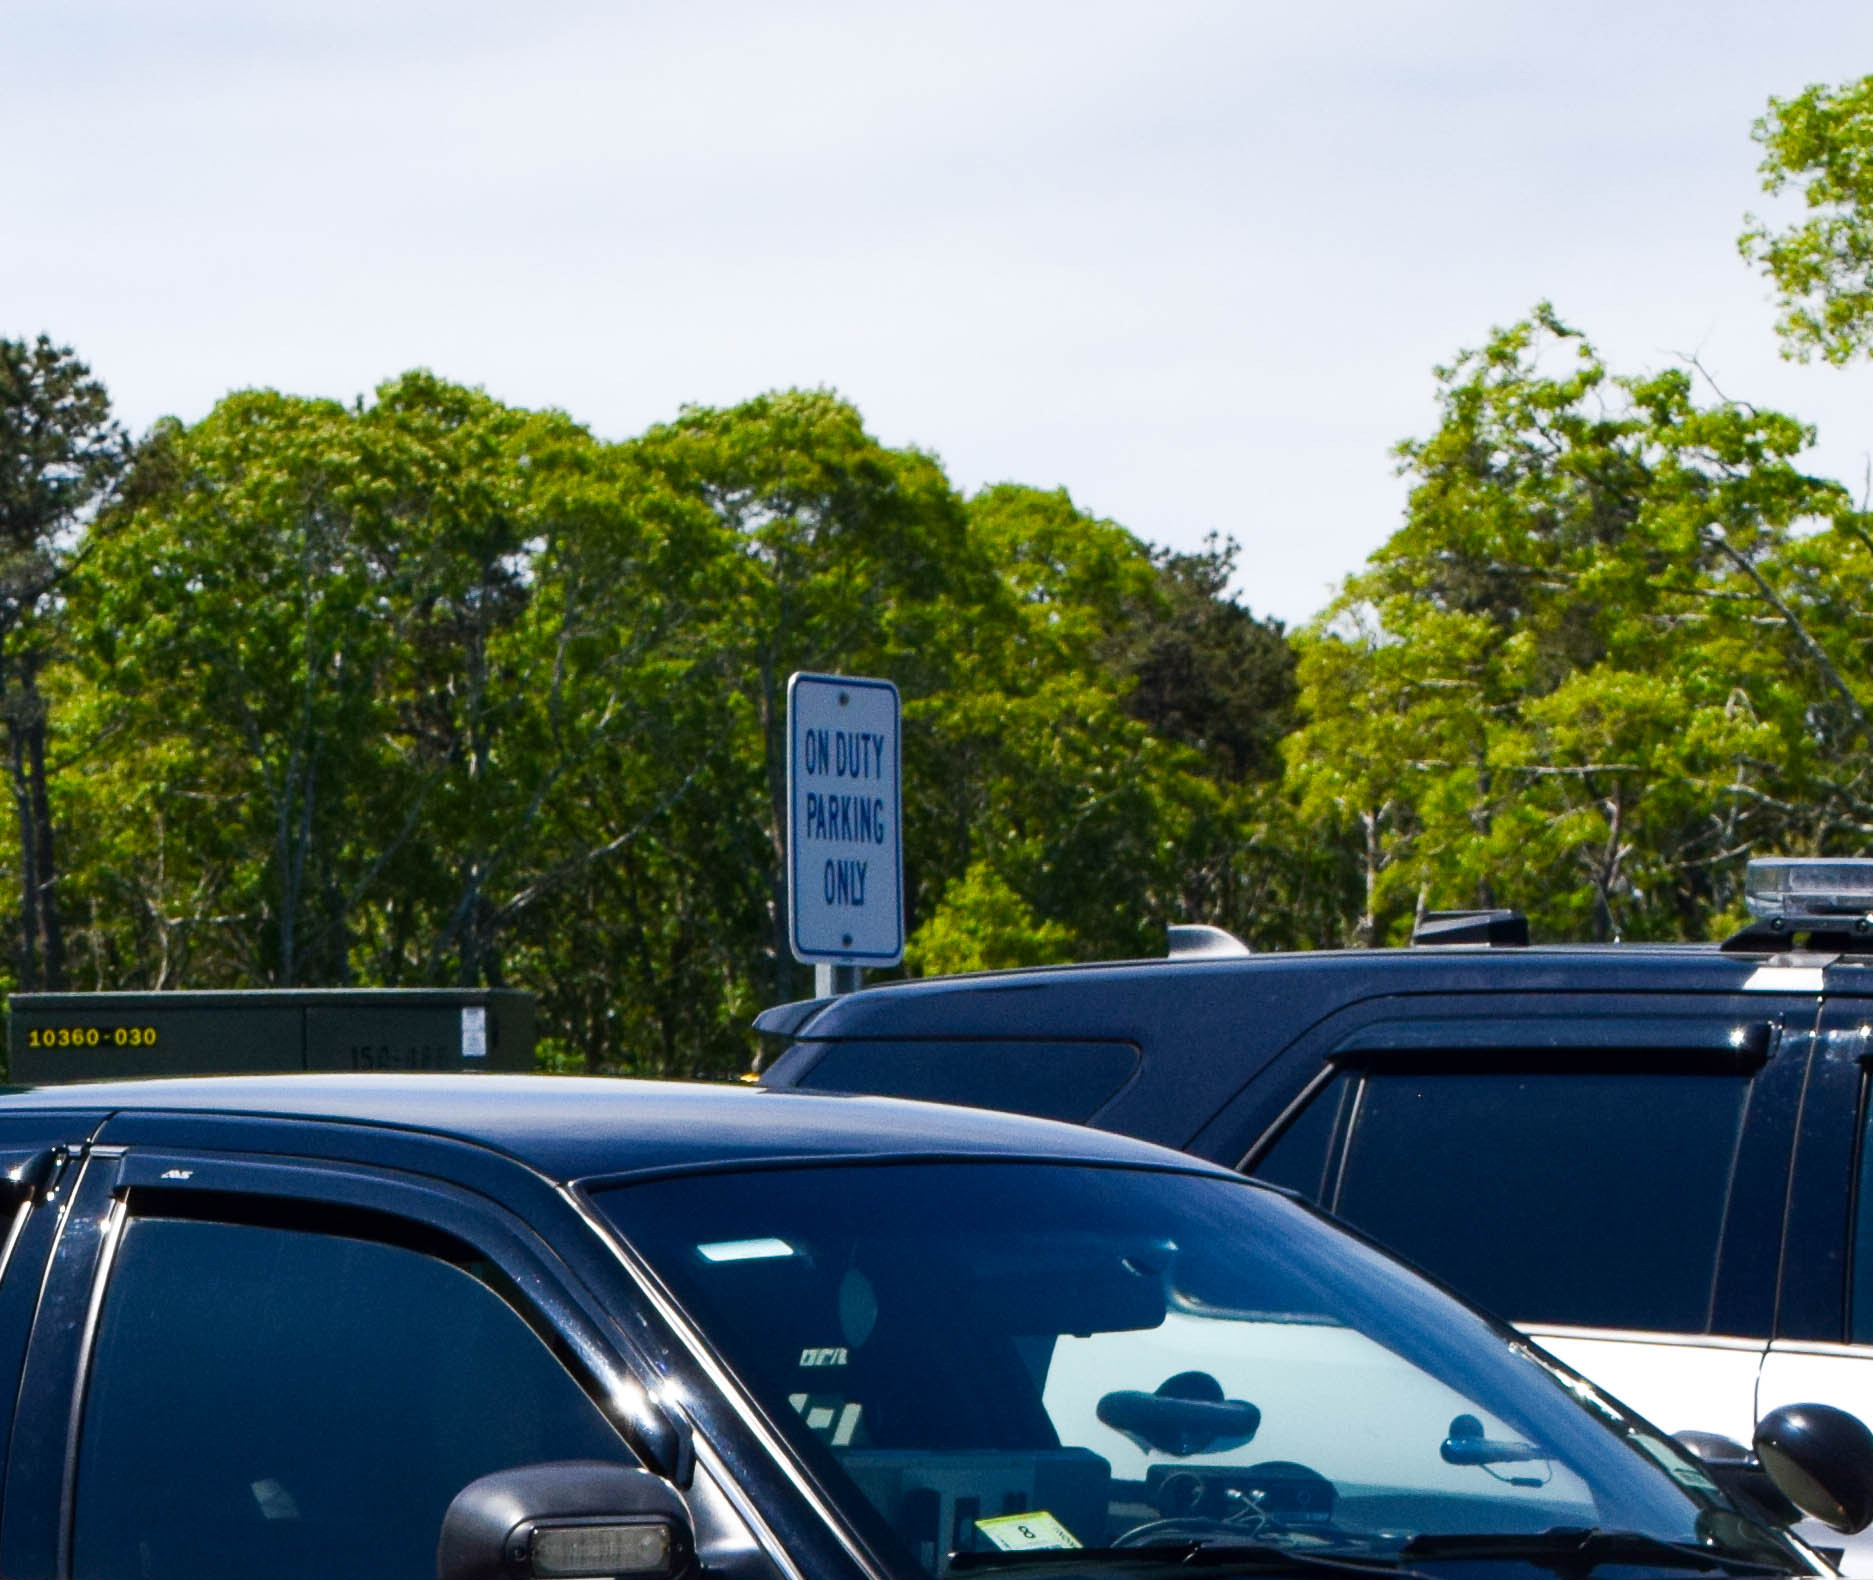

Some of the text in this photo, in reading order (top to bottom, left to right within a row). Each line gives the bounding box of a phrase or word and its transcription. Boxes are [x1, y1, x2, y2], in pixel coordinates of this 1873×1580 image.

[805, 728, 885, 780] ON DUTY
[806, 791, 885, 845] PARKING
[824, 857, 868, 907] ONLY
[28, 1027, 158, 1048] 10360-030
